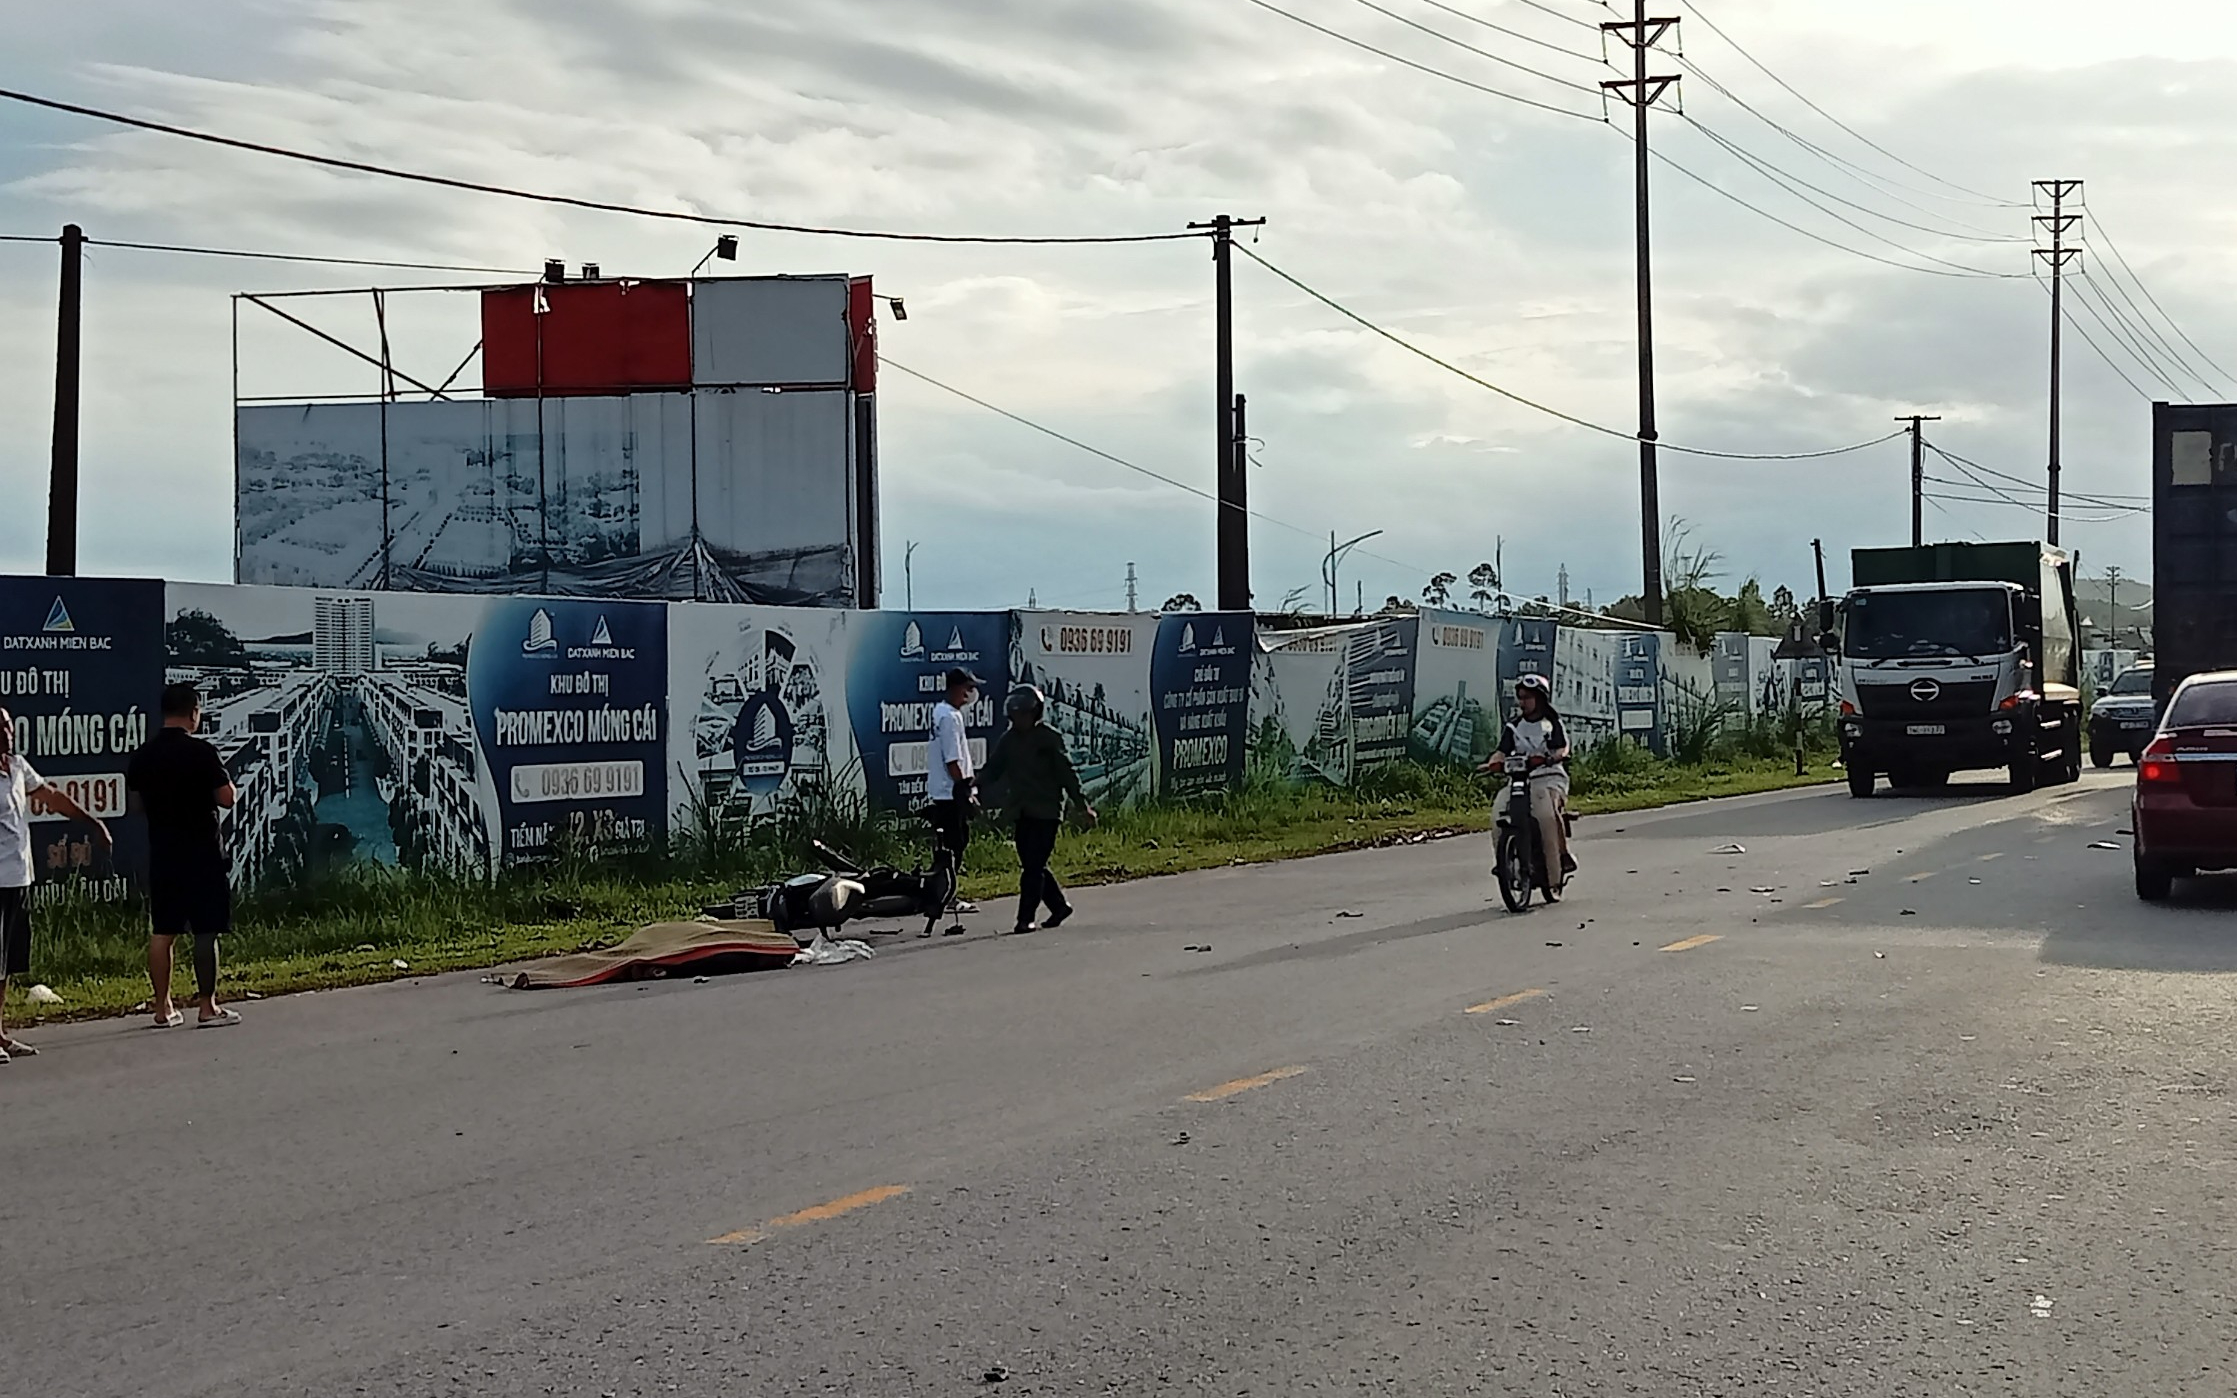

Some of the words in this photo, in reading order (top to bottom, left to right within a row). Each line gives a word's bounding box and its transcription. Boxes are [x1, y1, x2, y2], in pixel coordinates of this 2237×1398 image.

[4, 637, 57, 649] DATXANH
[90, 637, 112, 649] BAC
[1060, 628, 1086, 652] 0936
[1090, 628, 1103, 651] 69
[1106, 629, 1132, 653] 9191
[16, 667, 38, 694] ĐÔ
[43, 670, 69, 698] THỊ
[550, 674, 573, 694] KHU
[592, 673, 609, 697] THỊ
[495, 710, 584, 746] PROMEXCO
[588, 703, 630, 742] MÓNG
[632, 703, 656, 741] CÁI
[976, 695, 994, 727] CÁI
[37, 706, 104, 755] MÓNG
[109, 705, 146, 753] CÁI
[1173, 734, 1228, 770] PROMEXCO
[542, 769, 578, 797] 0936
[584, 768, 600, 795] 69
[606, 766, 640, 793] 9191
